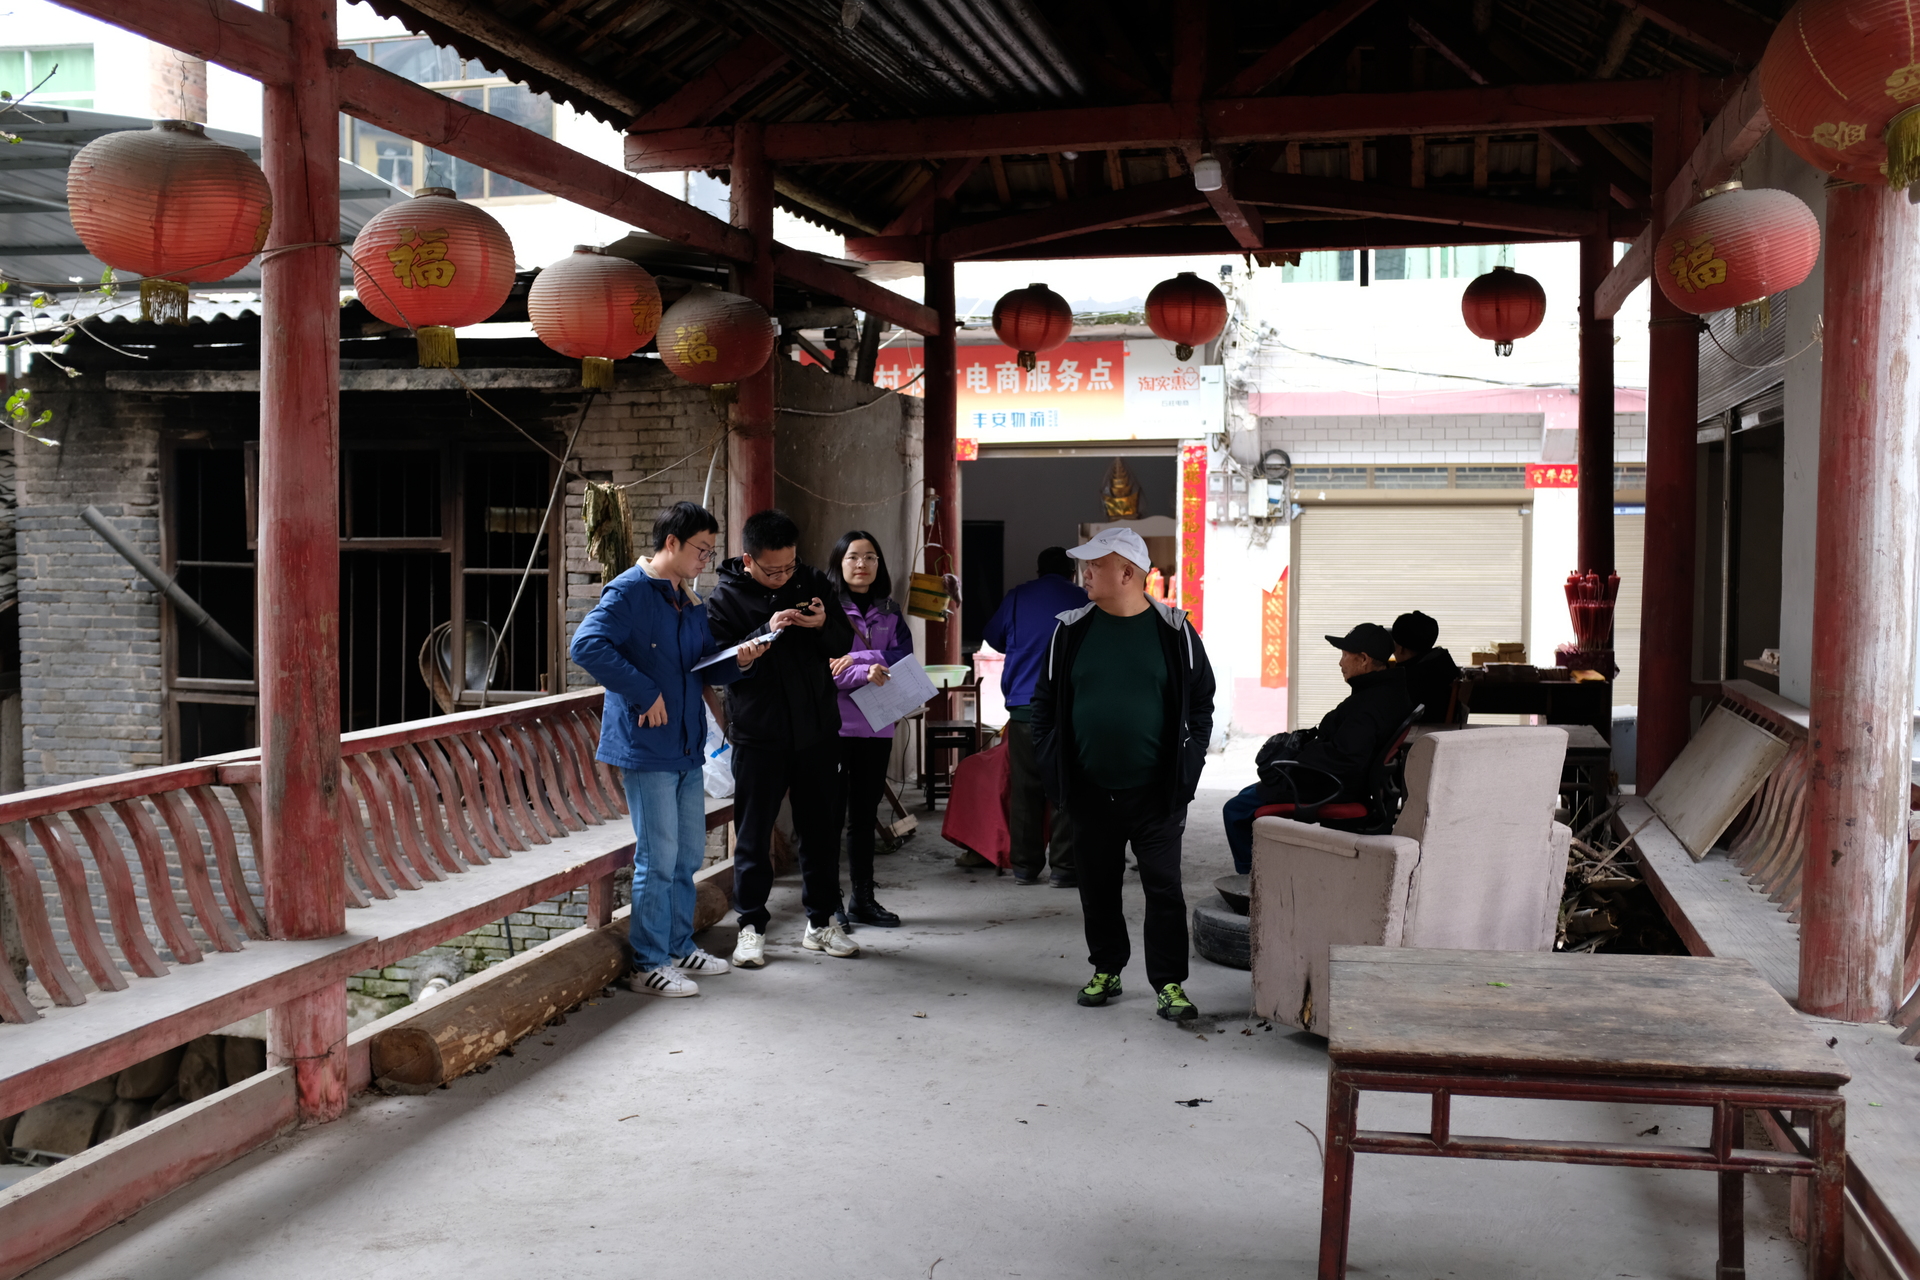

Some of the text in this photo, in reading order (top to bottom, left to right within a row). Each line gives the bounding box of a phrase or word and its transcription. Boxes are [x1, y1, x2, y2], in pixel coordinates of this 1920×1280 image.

[386, 227, 456, 289] 福
[1668, 232, 1728, 293] 福
[672, 324, 718, 367] 福
[875, 357, 1114, 394] 村农电商服务点
[1138, 373, 1187, 392] 淘实惠
[973, 411, 1045, 428] 丰安物流
[1531, 468, 1578, 485] 百年好
